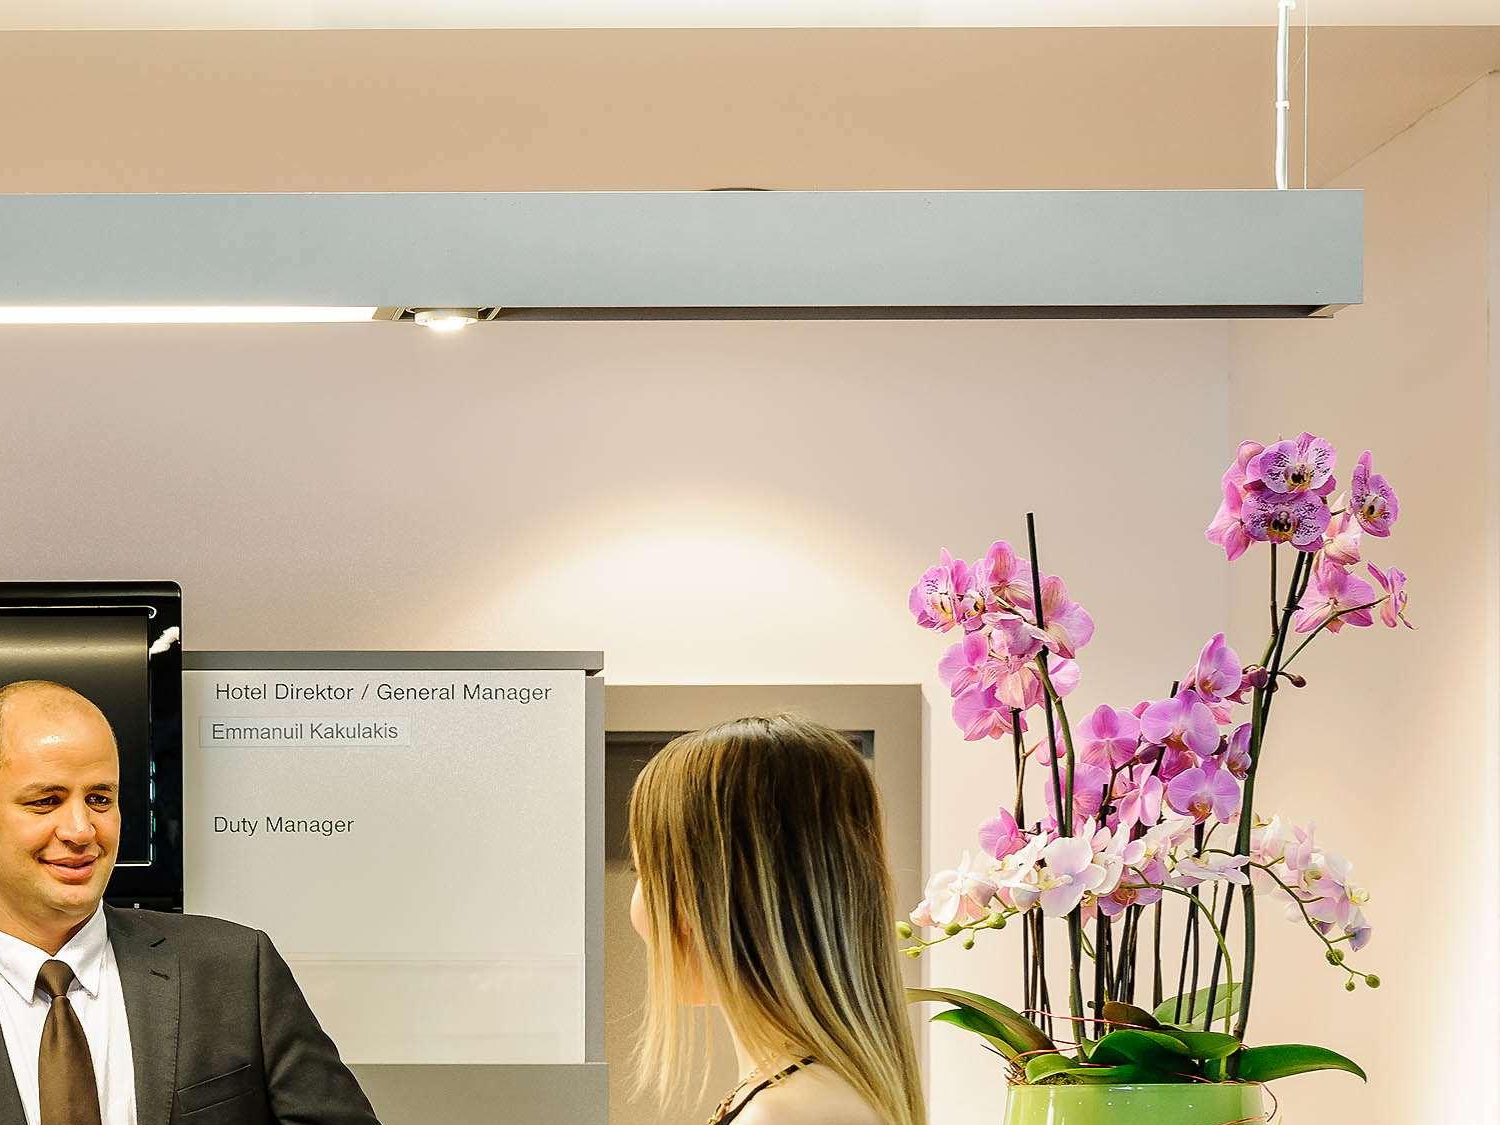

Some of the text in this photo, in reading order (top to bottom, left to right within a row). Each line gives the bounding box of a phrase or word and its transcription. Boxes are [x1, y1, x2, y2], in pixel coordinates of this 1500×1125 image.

[216, 683, 552, 705] Hotel Direktor / General Manager
[211, 722, 398, 740] Emmanuil Kakulakis
[214, 816, 354, 837] Duty Manager
